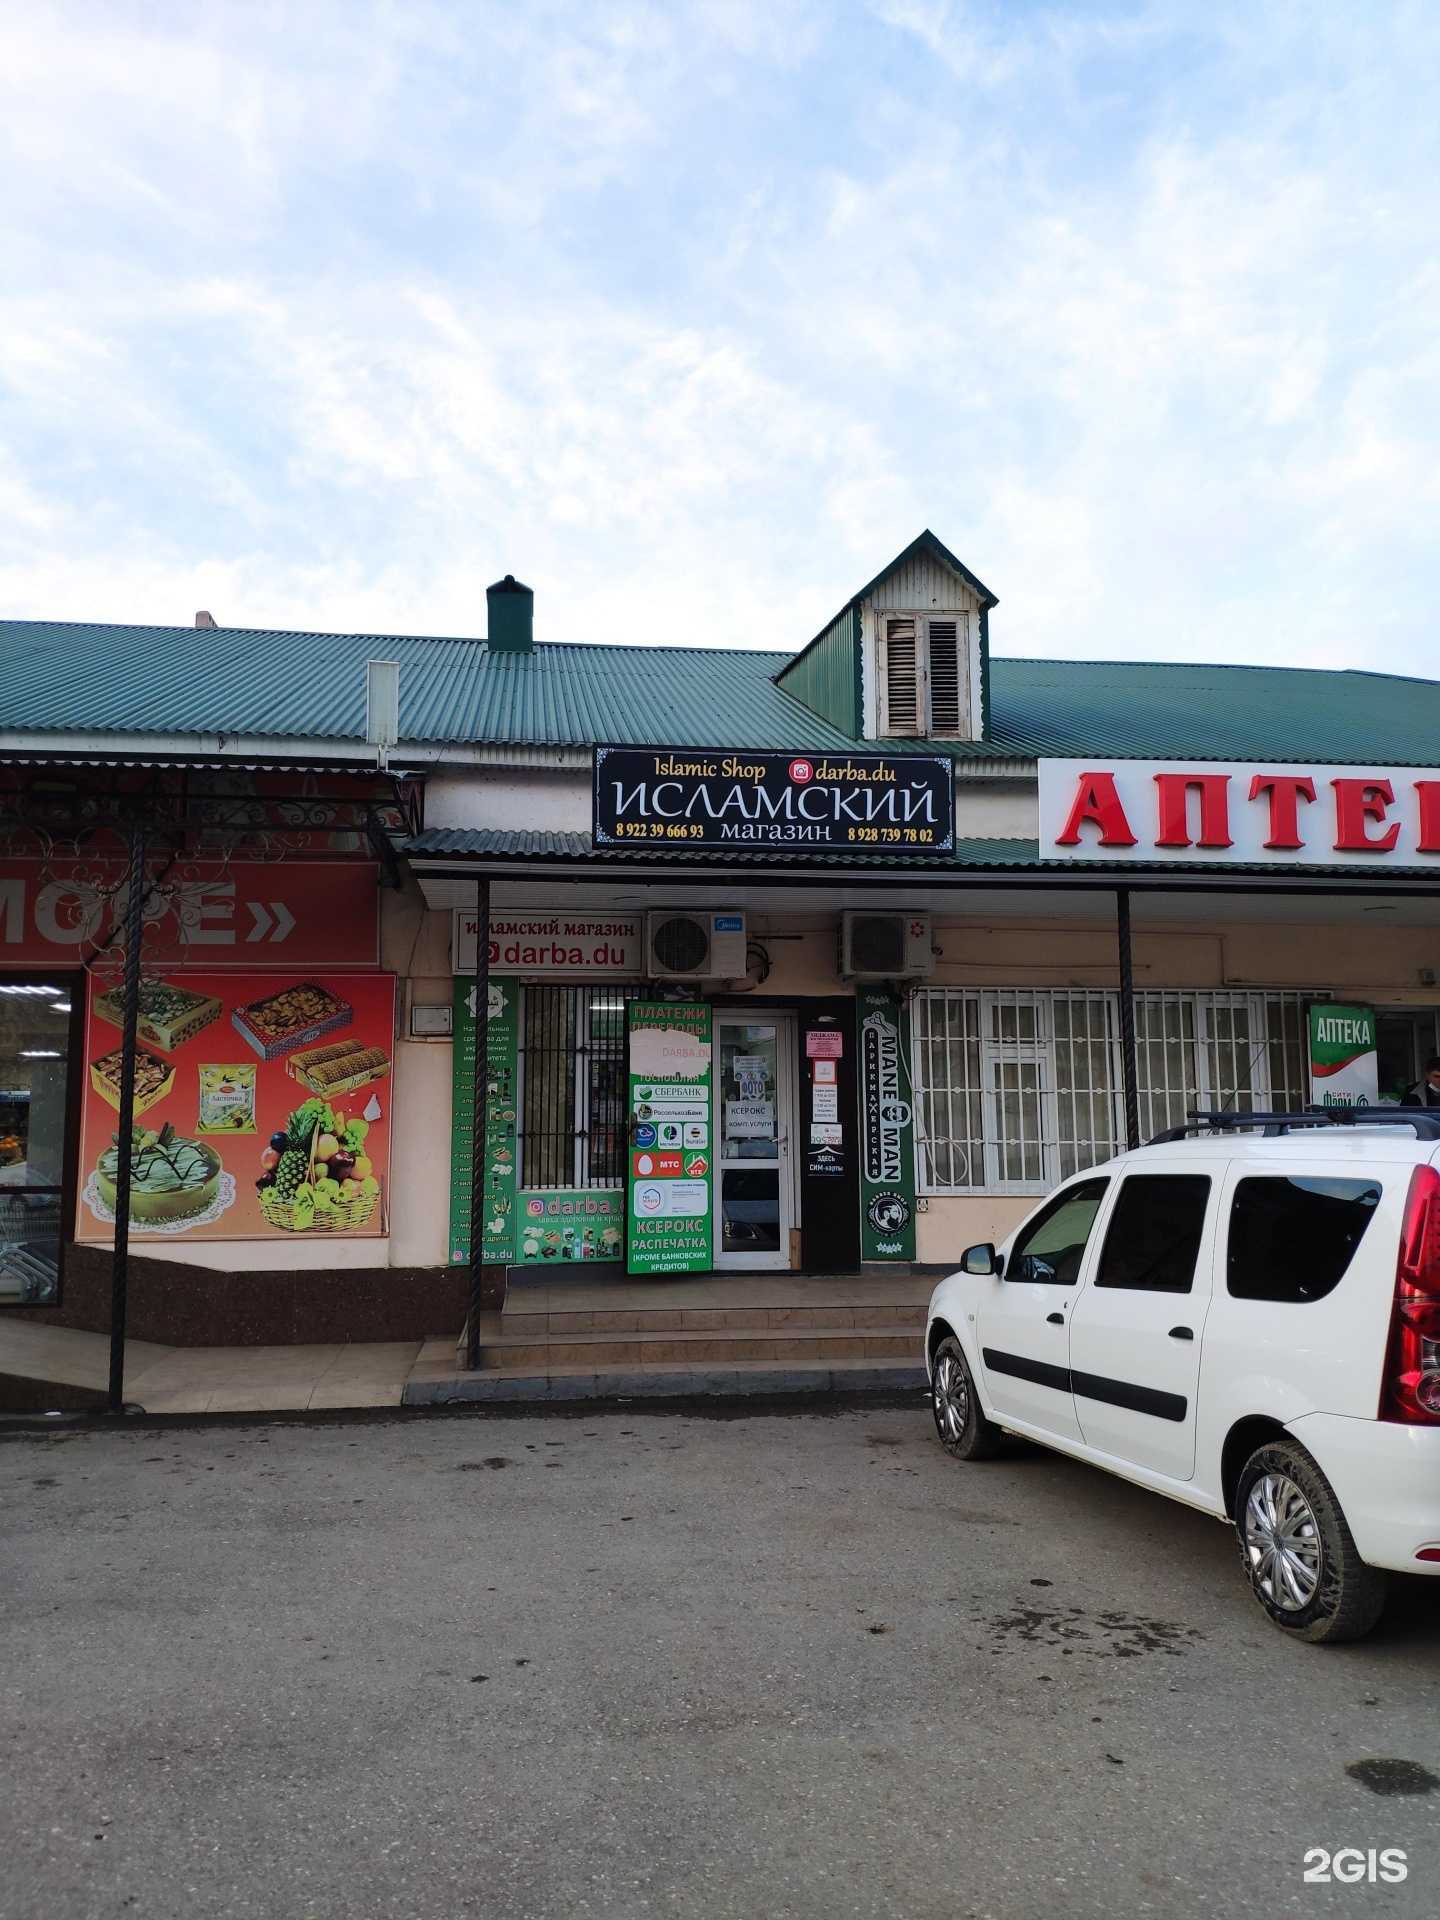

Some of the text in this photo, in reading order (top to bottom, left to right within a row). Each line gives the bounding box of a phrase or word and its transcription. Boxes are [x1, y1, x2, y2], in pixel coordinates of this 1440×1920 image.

[654, 756, 767, 784] Islamic Shop
[815, 761, 897, 782] darba.du
[611, 781, 938, 823] ИСЛАМСКИЙ
[616, 823, 704, 839] 8 922 39 666 93
[720, 823, 832, 841] магазин
[848, 827, 934, 843] 8 928 739 78 02
[466, 918, 635, 937] иламский магазин
[504, 941, 625, 965] darba.du
[1317, 1017, 1371, 1044] АПТЕКА
[655, 1088, 701, 1096] СБЕРБАНК
[731, 1107, 766, 1115] КСЕРОКС
[882, 1036, 899, 1180] MANE MAN
[660, 1160, 680, 1169] МТС
[636, 1219, 704, 1234] КСЕРОКС
[632, 1238, 707, 1249] РАСПЕЧАТКА
